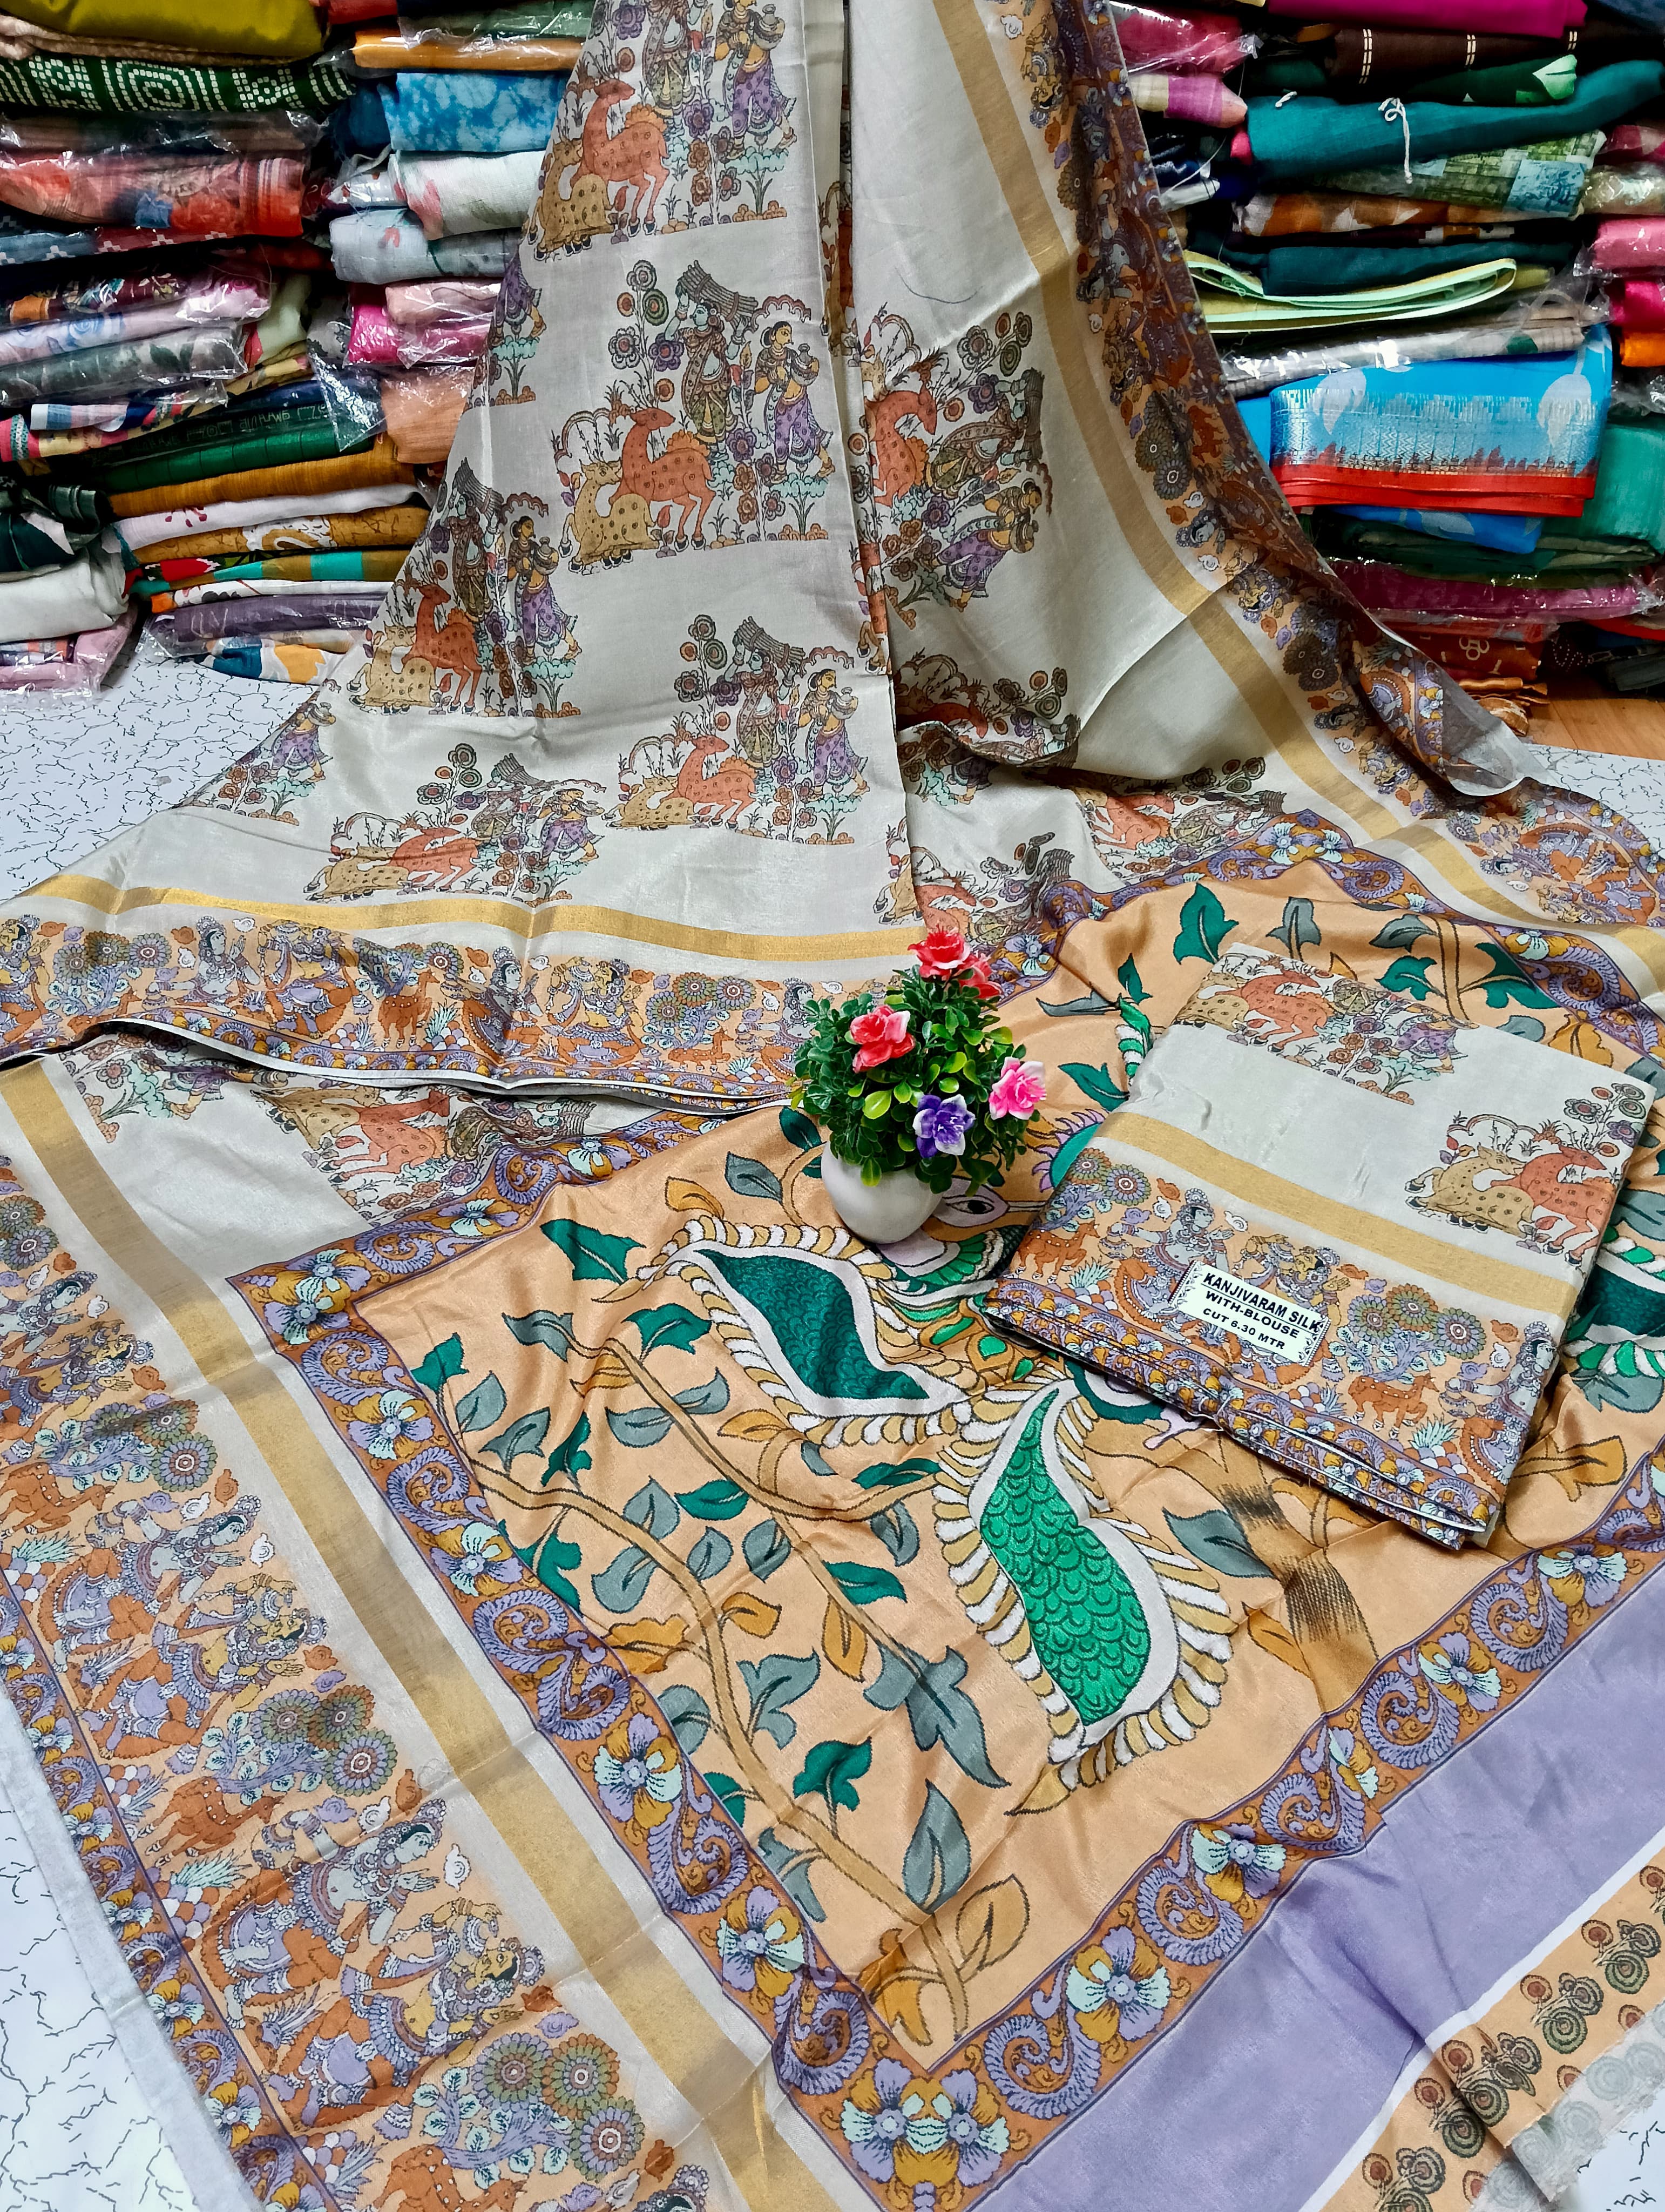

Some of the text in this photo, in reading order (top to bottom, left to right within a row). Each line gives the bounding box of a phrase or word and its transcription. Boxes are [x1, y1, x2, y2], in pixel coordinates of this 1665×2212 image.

[1203, 1272, 1321, 1333] KANJIVARAM SILK
[1206, 1291, 1299, 1338] WITH-BLOUSE
[1203, 1308, 1285, 1350] CUT 6.30 MTR
